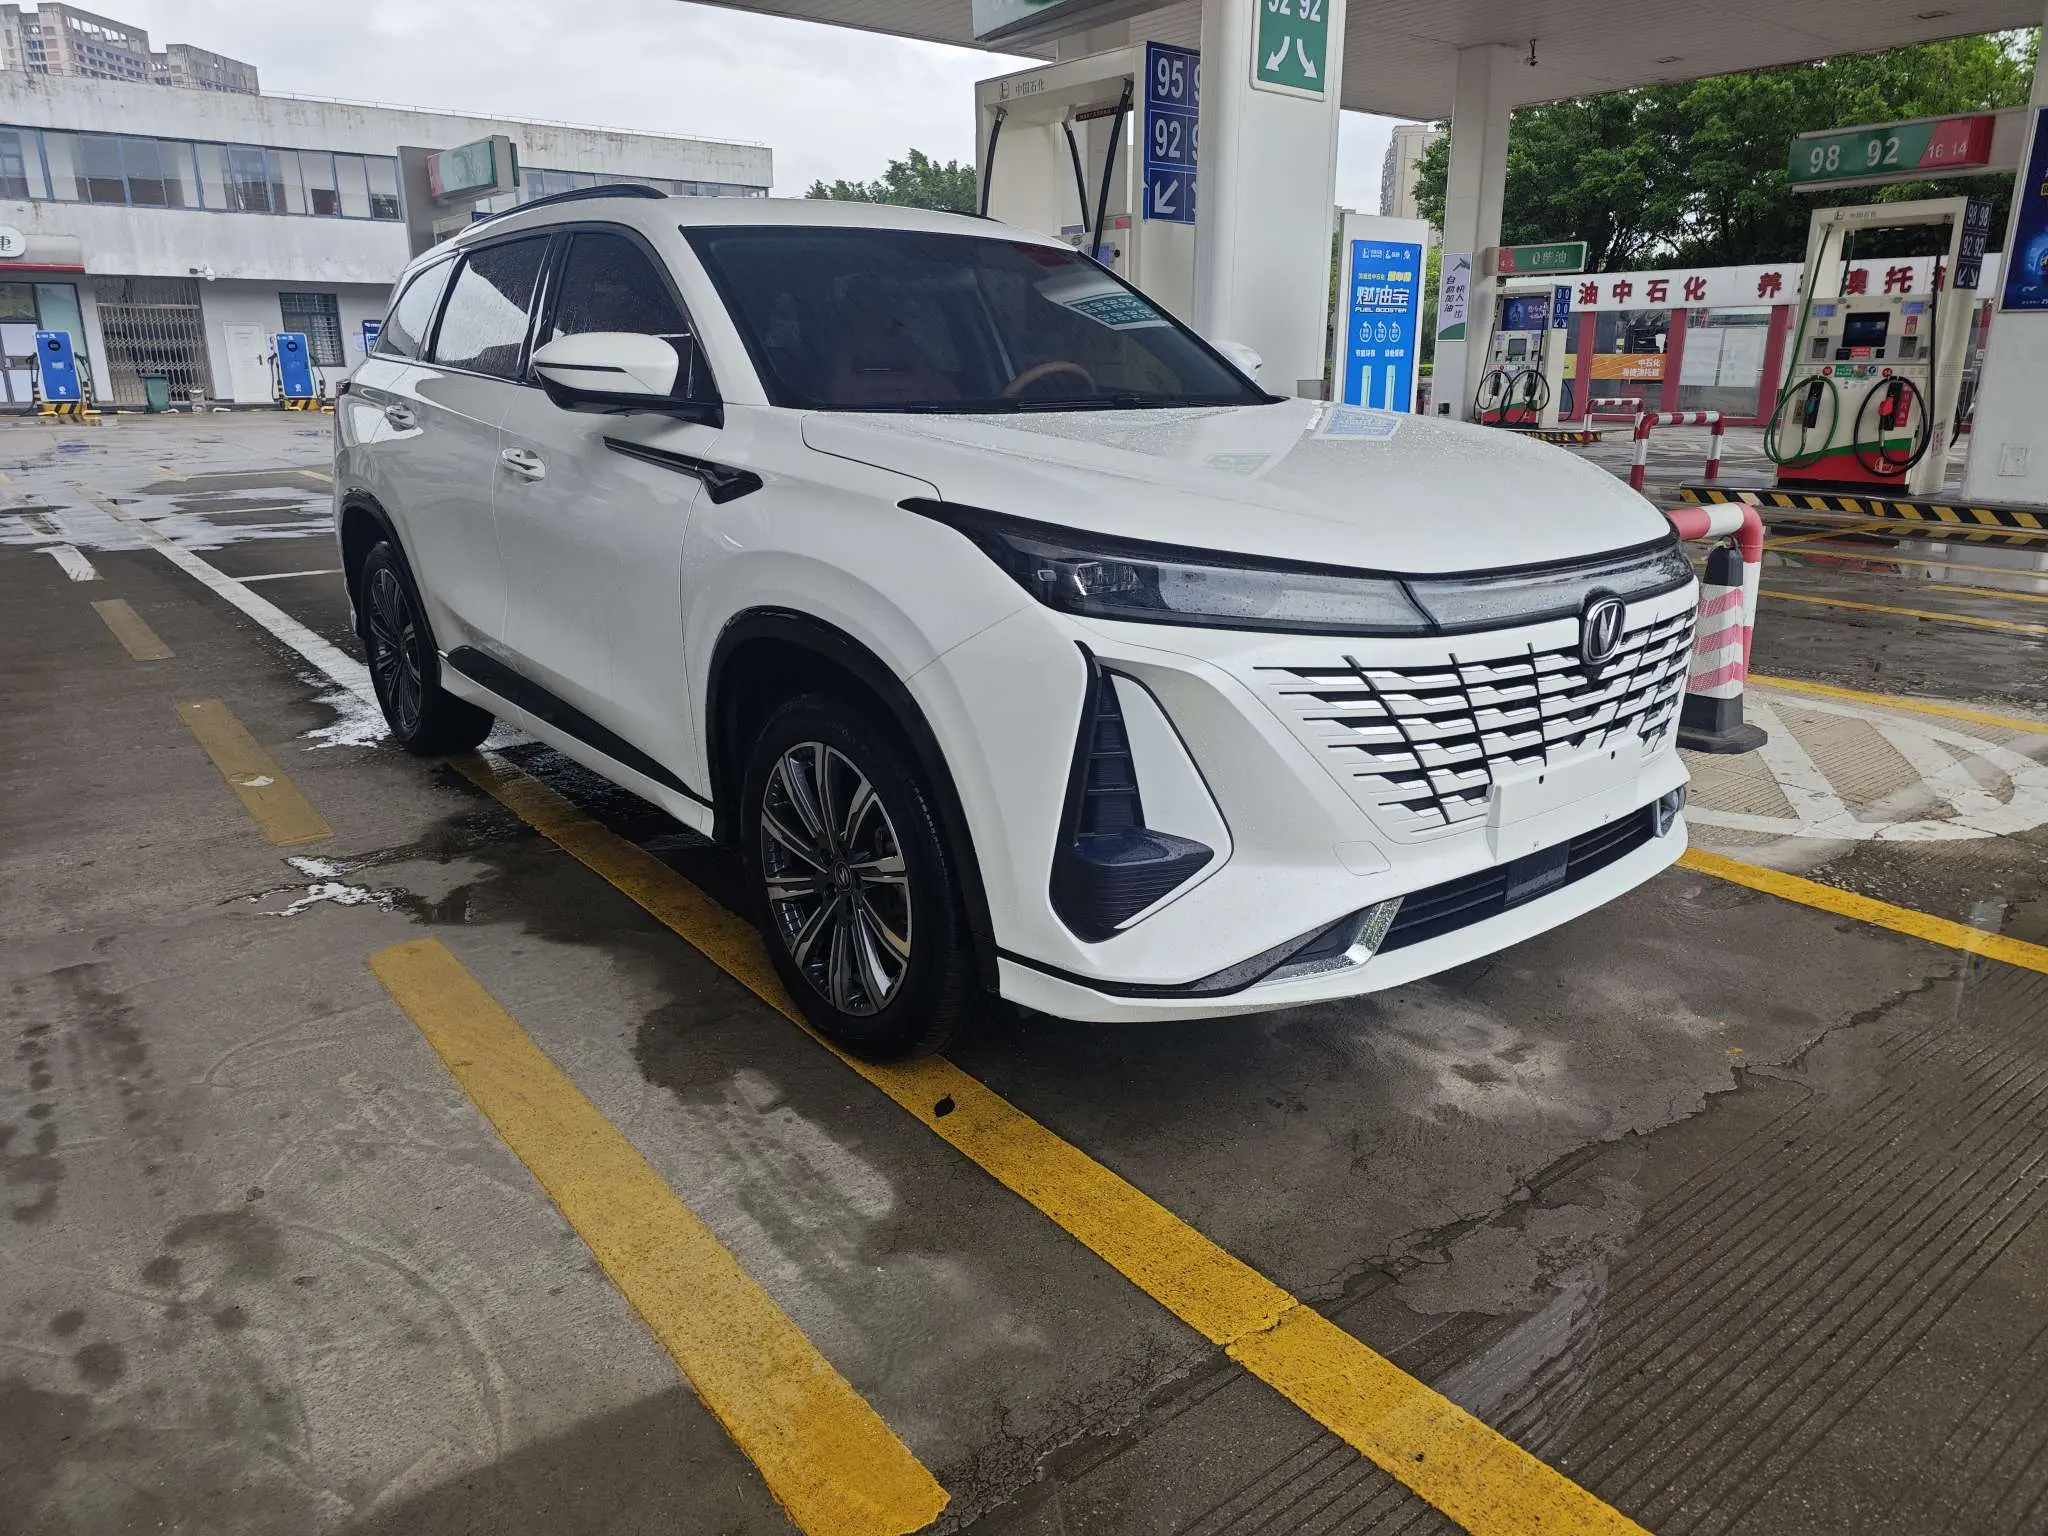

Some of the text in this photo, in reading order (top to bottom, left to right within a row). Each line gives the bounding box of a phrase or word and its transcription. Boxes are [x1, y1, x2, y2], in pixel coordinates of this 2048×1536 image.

[1015, 79, 1045, 96] 中国石化
[1157, 57, 1184, 98] 95
[1155, 118, 1182, 158] 92
[1809, 136, 1968, 174] 98 92 16 14
[1967, 203, 1978, 225] 98
[1962, 235, 1985, 257] 92 92
[1356, 284, 1410, 306] 燃油宝
